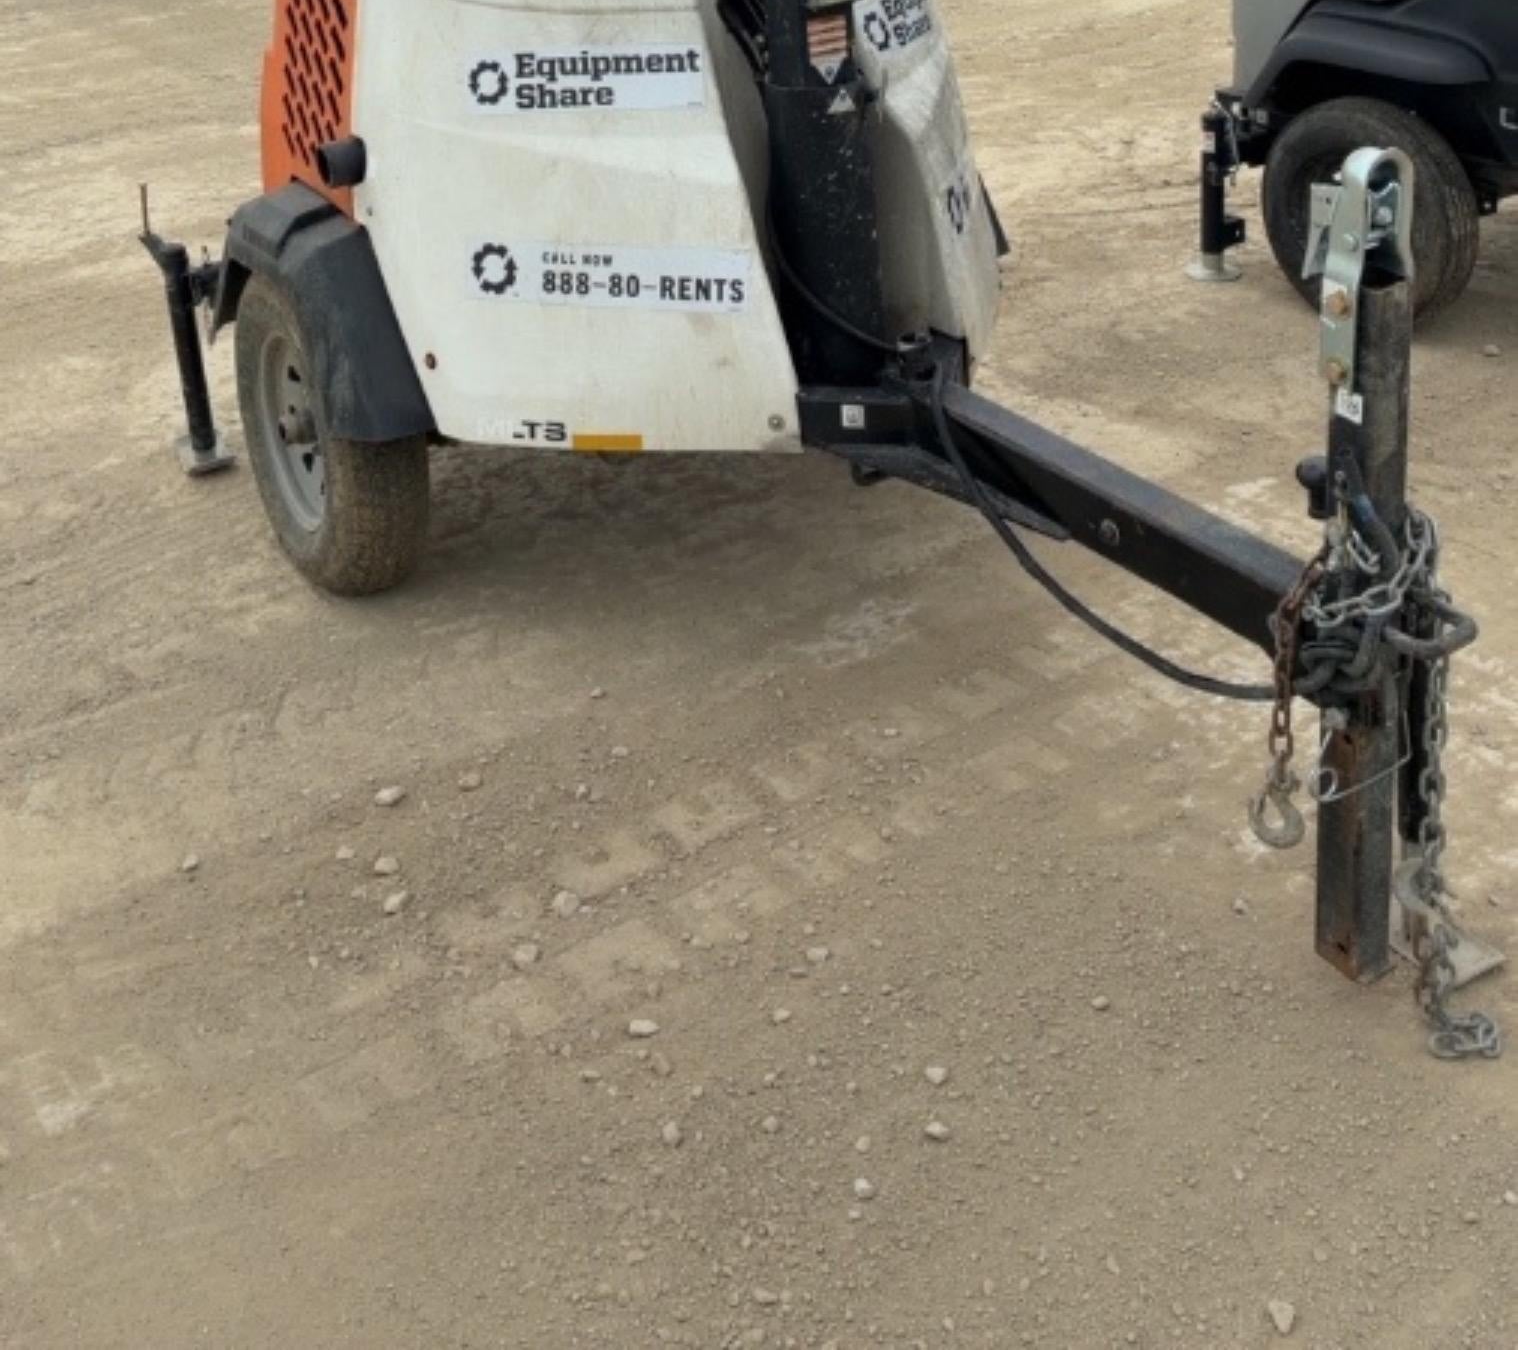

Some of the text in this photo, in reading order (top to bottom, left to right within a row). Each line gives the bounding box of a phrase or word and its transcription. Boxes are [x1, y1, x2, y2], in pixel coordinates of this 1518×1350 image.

[515, 48, 700, 82] Equipment
[515, 83, 615, 109] Share
[542, 252, 613, 266] CALL NOW
[542, 270, 745, 303] 888-80-RENTS
